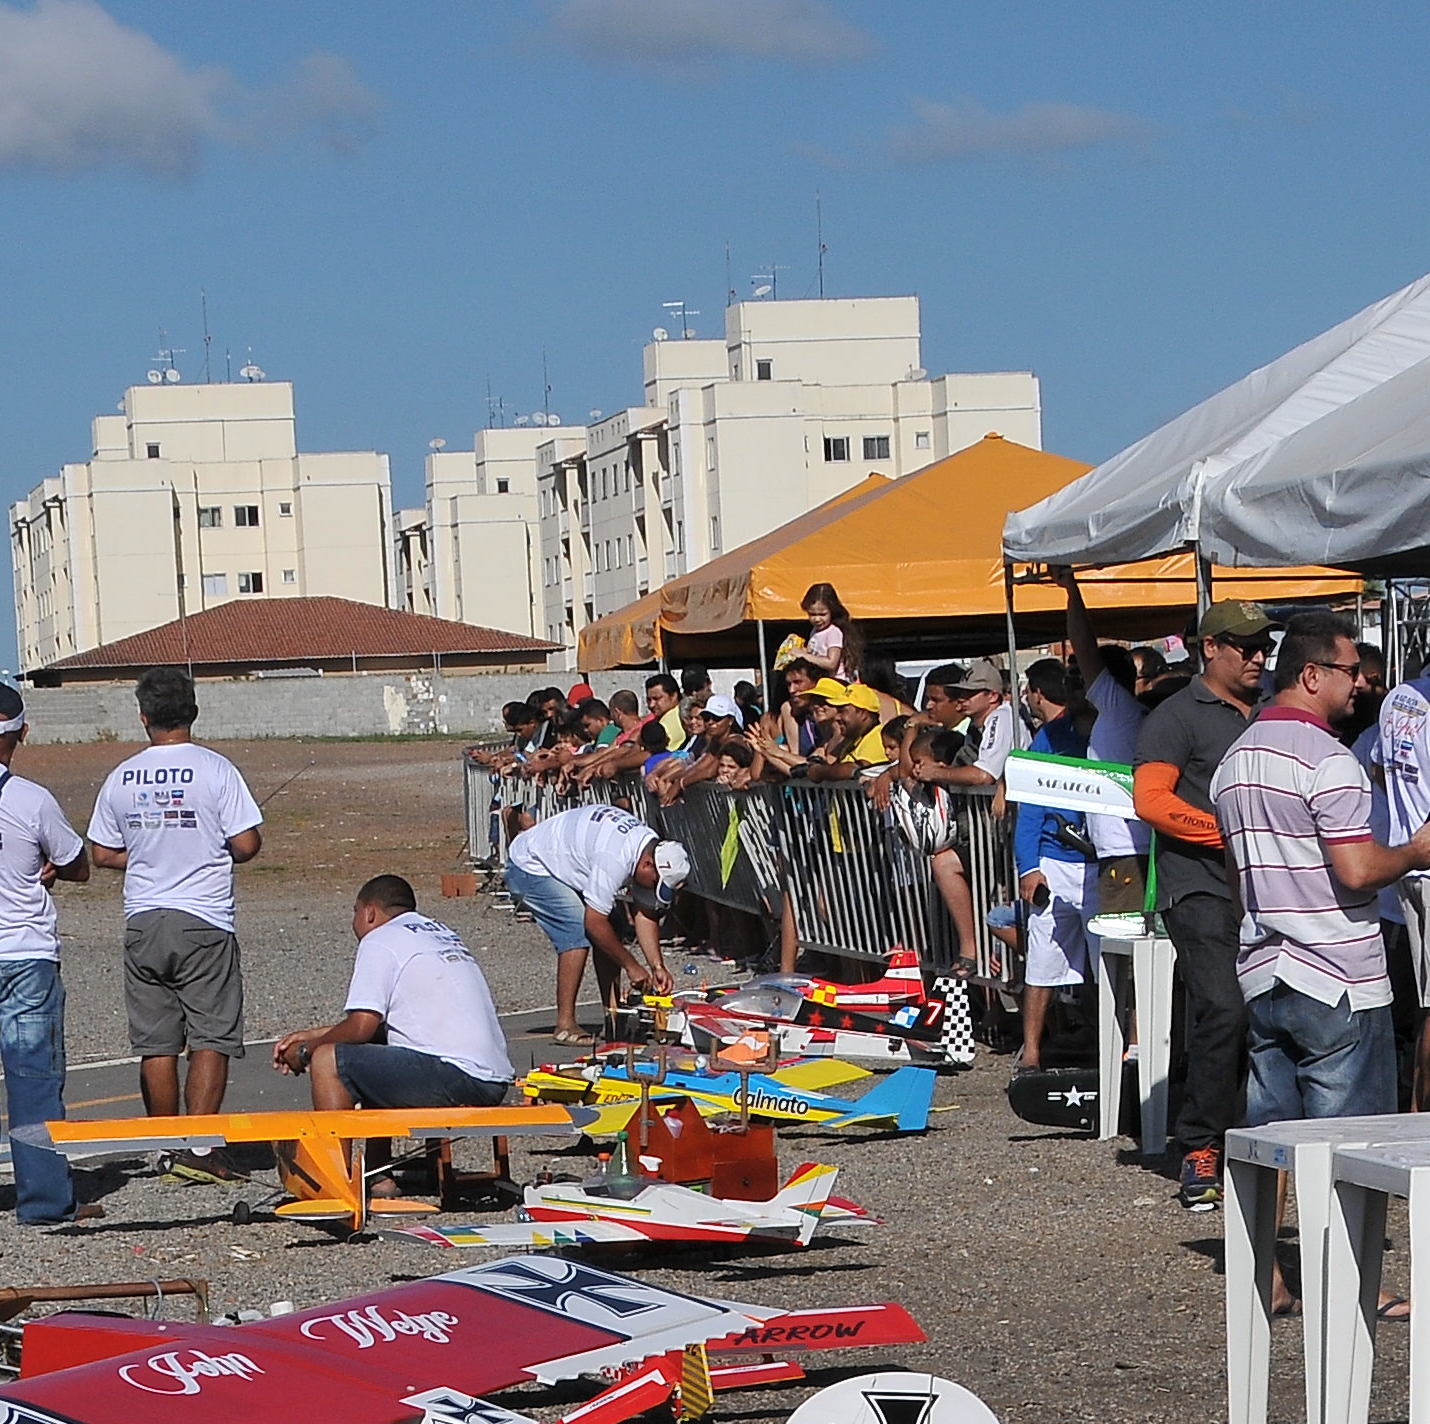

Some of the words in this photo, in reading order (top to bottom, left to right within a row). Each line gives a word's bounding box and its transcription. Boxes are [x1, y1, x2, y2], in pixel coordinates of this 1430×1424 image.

[122, 768, 194, 786] PILOTO
[926, 1000, 944, 1026] 7
[732, 1086, 810, 1117] Calmato
[734, 1320, 868, 1346] ARROW
